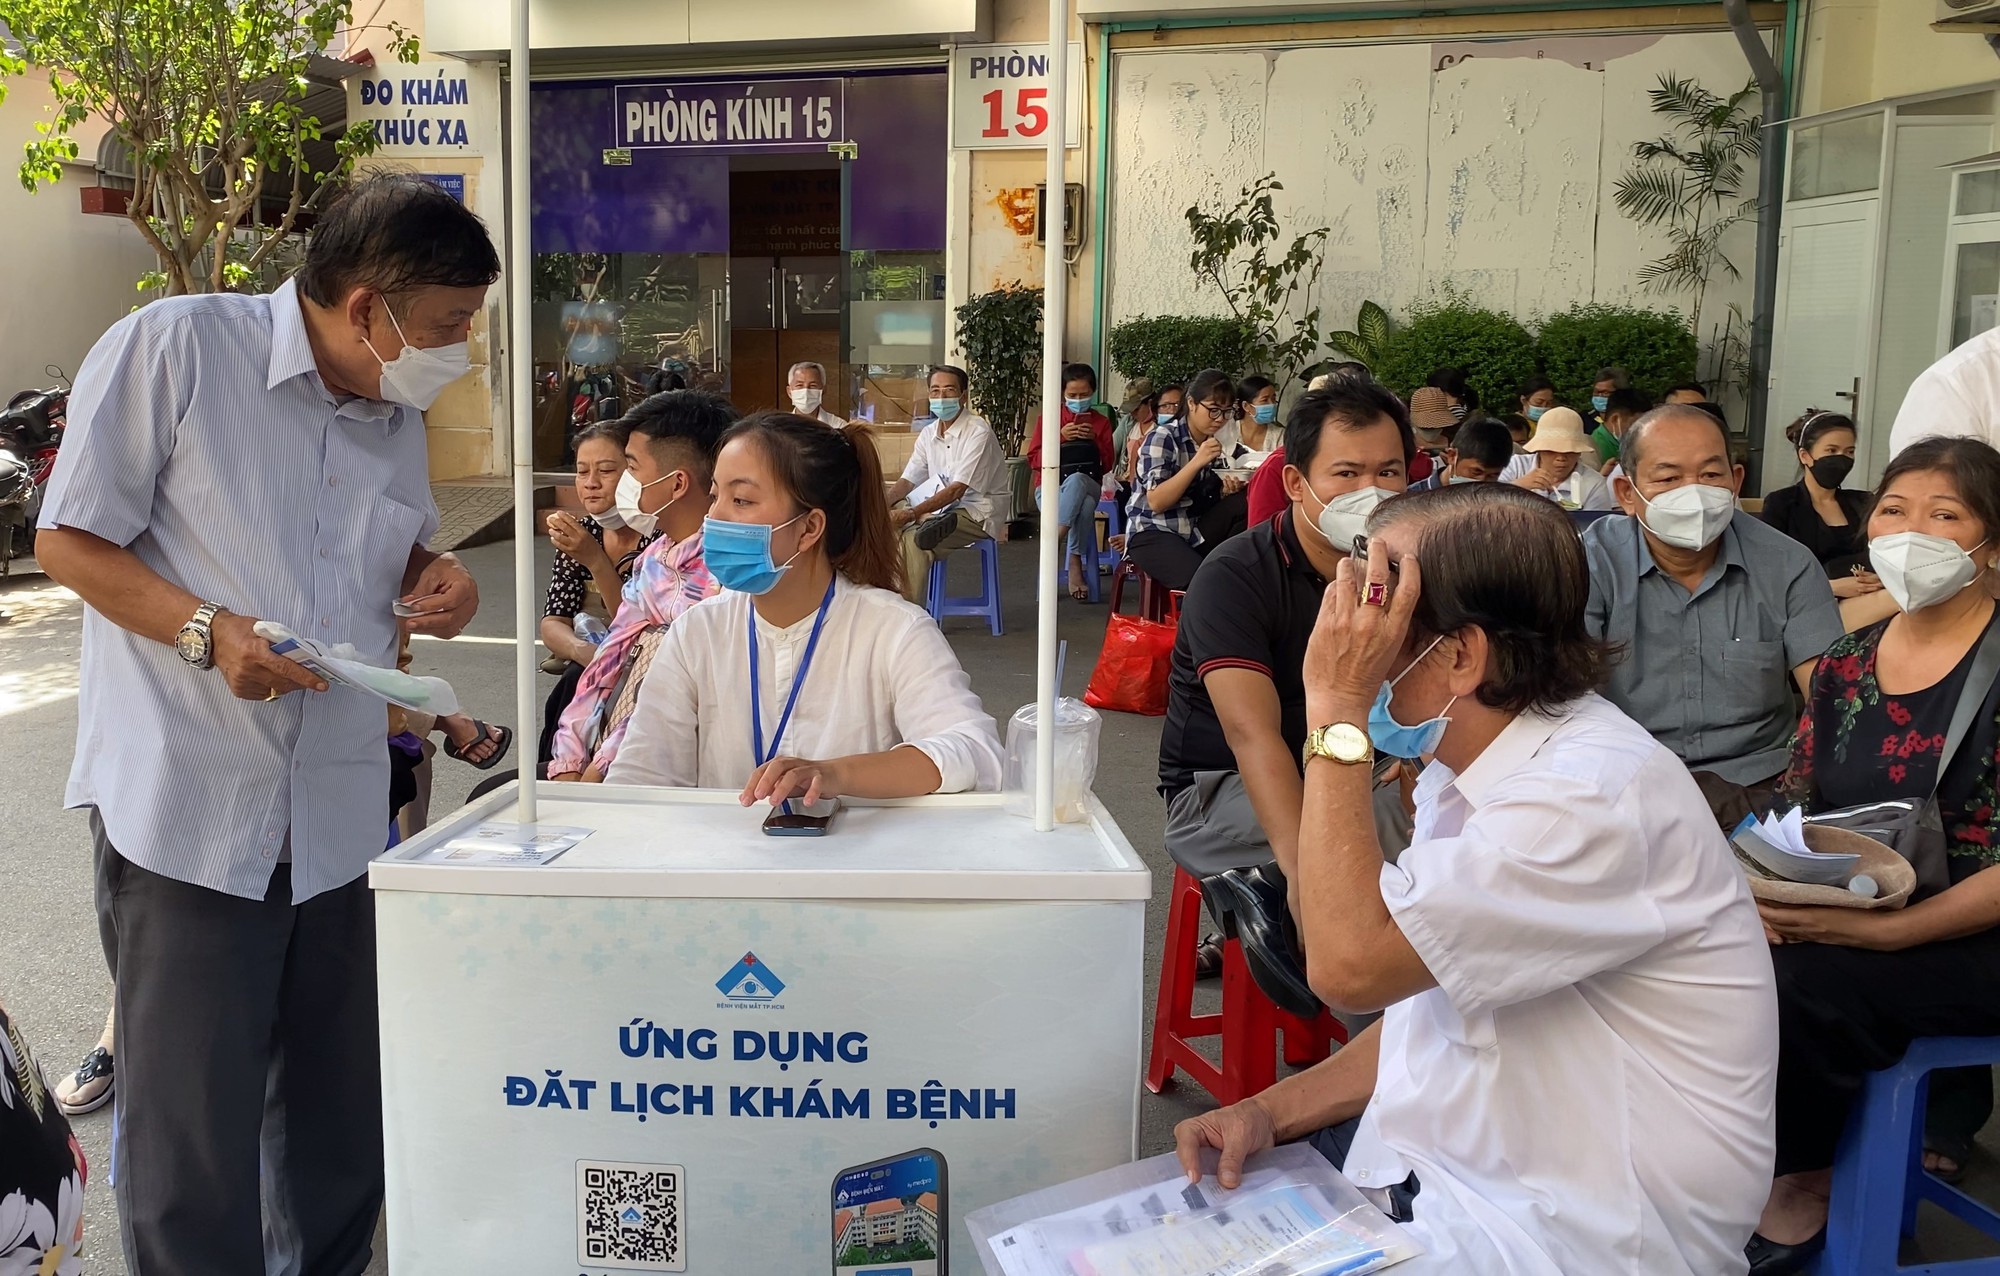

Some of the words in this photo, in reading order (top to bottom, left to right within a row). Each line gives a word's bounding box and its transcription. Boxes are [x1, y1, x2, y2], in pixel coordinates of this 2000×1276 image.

[361, 79, 393, 105] ĐO
[401, 69, 468, 105] KHÁM
[970, 50, 1049, 79] PHÒN
[437, 119, 469, 150] XẠ
[626, 88, 718, 143] PHÒNG
[726, 86, 792, 140] KÍNH
[802, 96, 833, 139] 15
[982, 88, 1048, 138] 15
[619, 1017, 718, 1061] ỨNG
[733, 1030, 868, 1072] DỤNG
[503, 1069, 597, 1111] ĐĂT
[610, 1081, 713, 1123] LỊCH
[730, 1078, 870, 1119] KHÁM
[886, 1079, 1016, 1129] BỆNH
